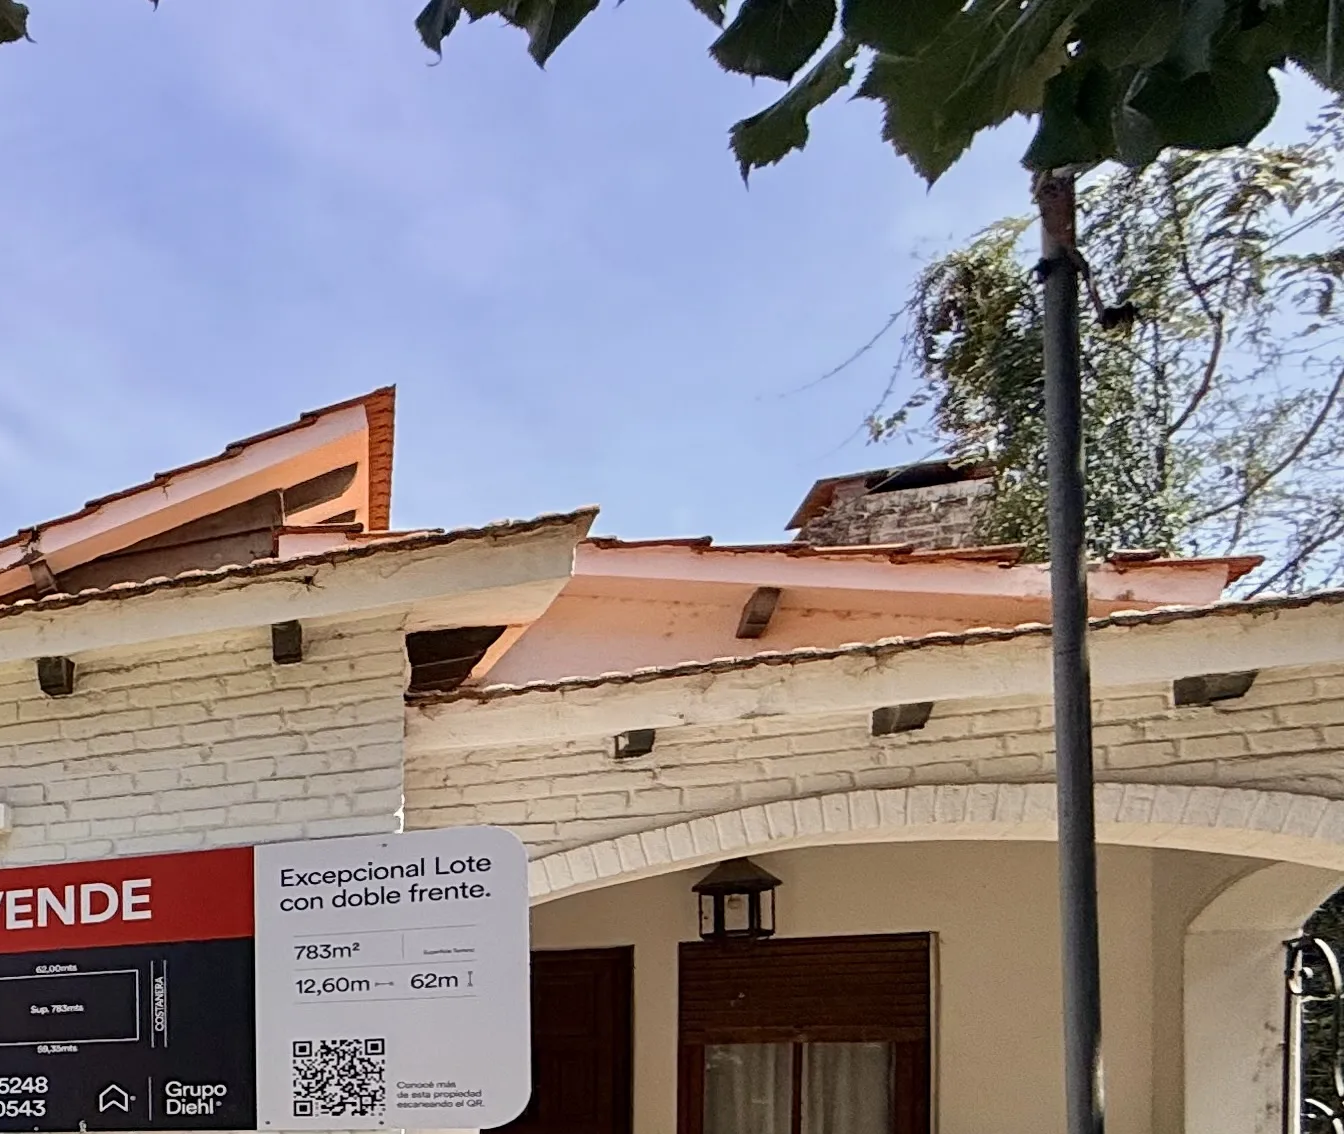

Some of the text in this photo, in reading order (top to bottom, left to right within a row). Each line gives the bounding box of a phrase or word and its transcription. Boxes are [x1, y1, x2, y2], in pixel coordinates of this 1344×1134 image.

[280, 856, 492, 888] Excepcional Lote
[279, 881, 492, 912] con doble frente.
[293, 942, 361, 960] 783m²
[295, 972, 459, 997] 12,60m 62m
[154, 976, 165, 1032] COSTANERA
[165, 1080, 227, 1100] Grupo
[396, 1091, 409, 1099] de
[433, 1089, 482, 1099] propiedad
[166, 1098, 214, 1115] Diehl
